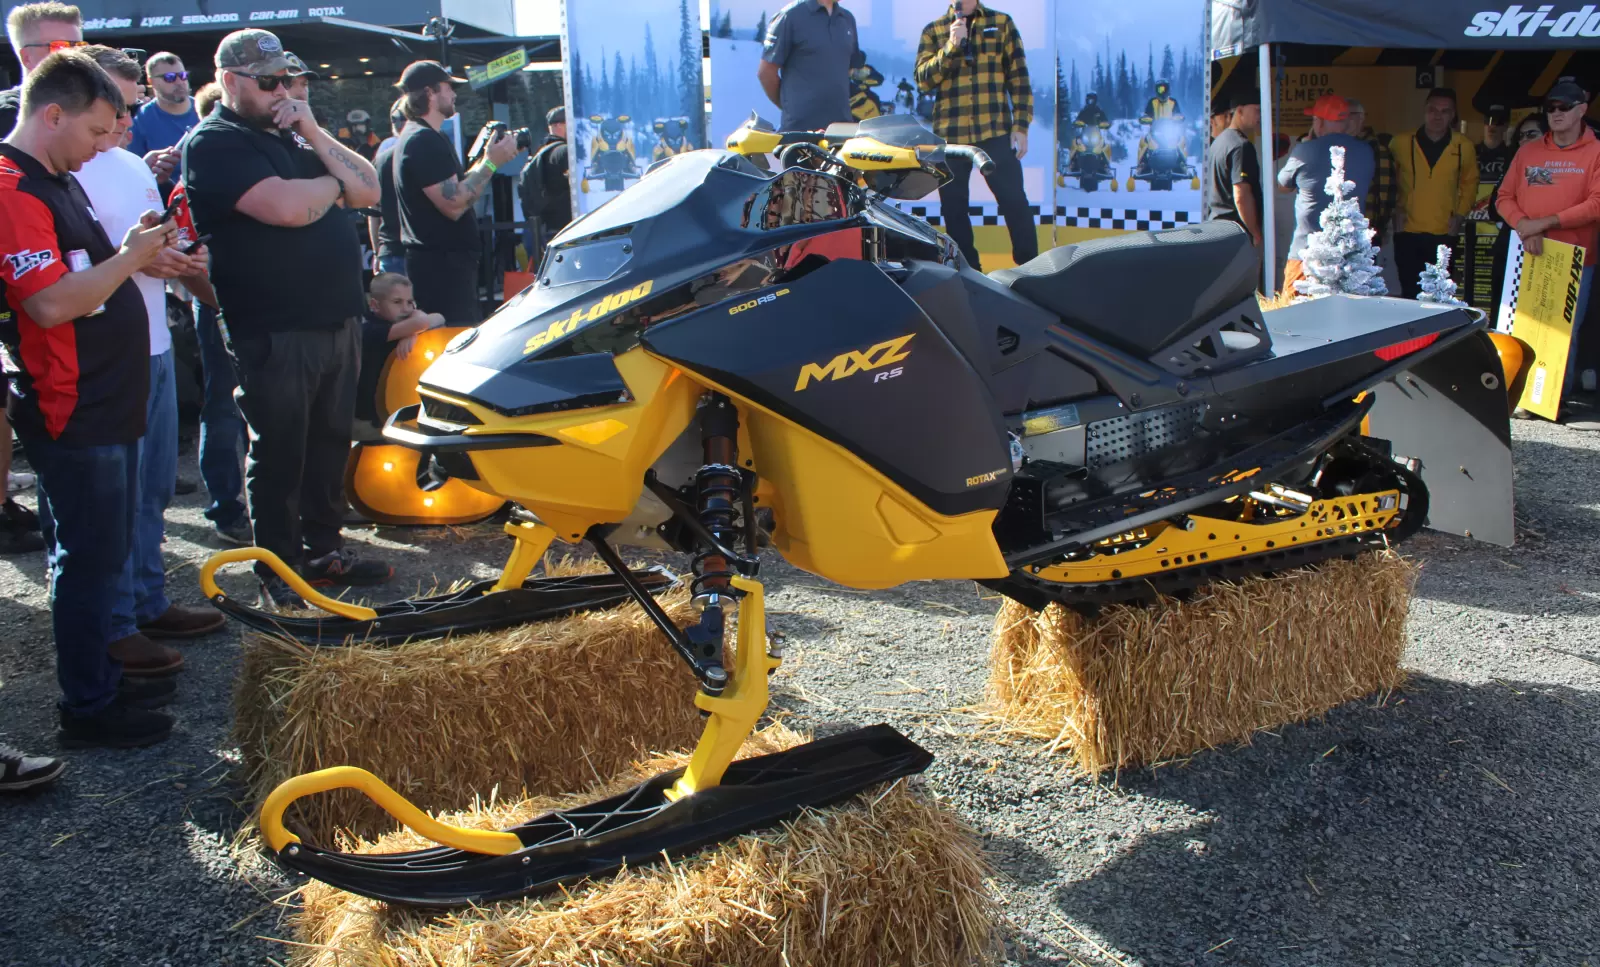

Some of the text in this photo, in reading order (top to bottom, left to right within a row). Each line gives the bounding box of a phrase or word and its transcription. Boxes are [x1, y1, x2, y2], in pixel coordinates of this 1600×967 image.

[140, 16, 173, 27] LYNX
[249, 9, 299, 21] can-am
[308, 7, 345, 17] ROTAX
[1563, 246, 1583, 324] ski-doo
[523, 280, 654, 355] ski-doo
[794, 333, 917, 392] MXZ
[874, 366, 904, 383] RS
[966, 471, 996, 487] ROTAX
